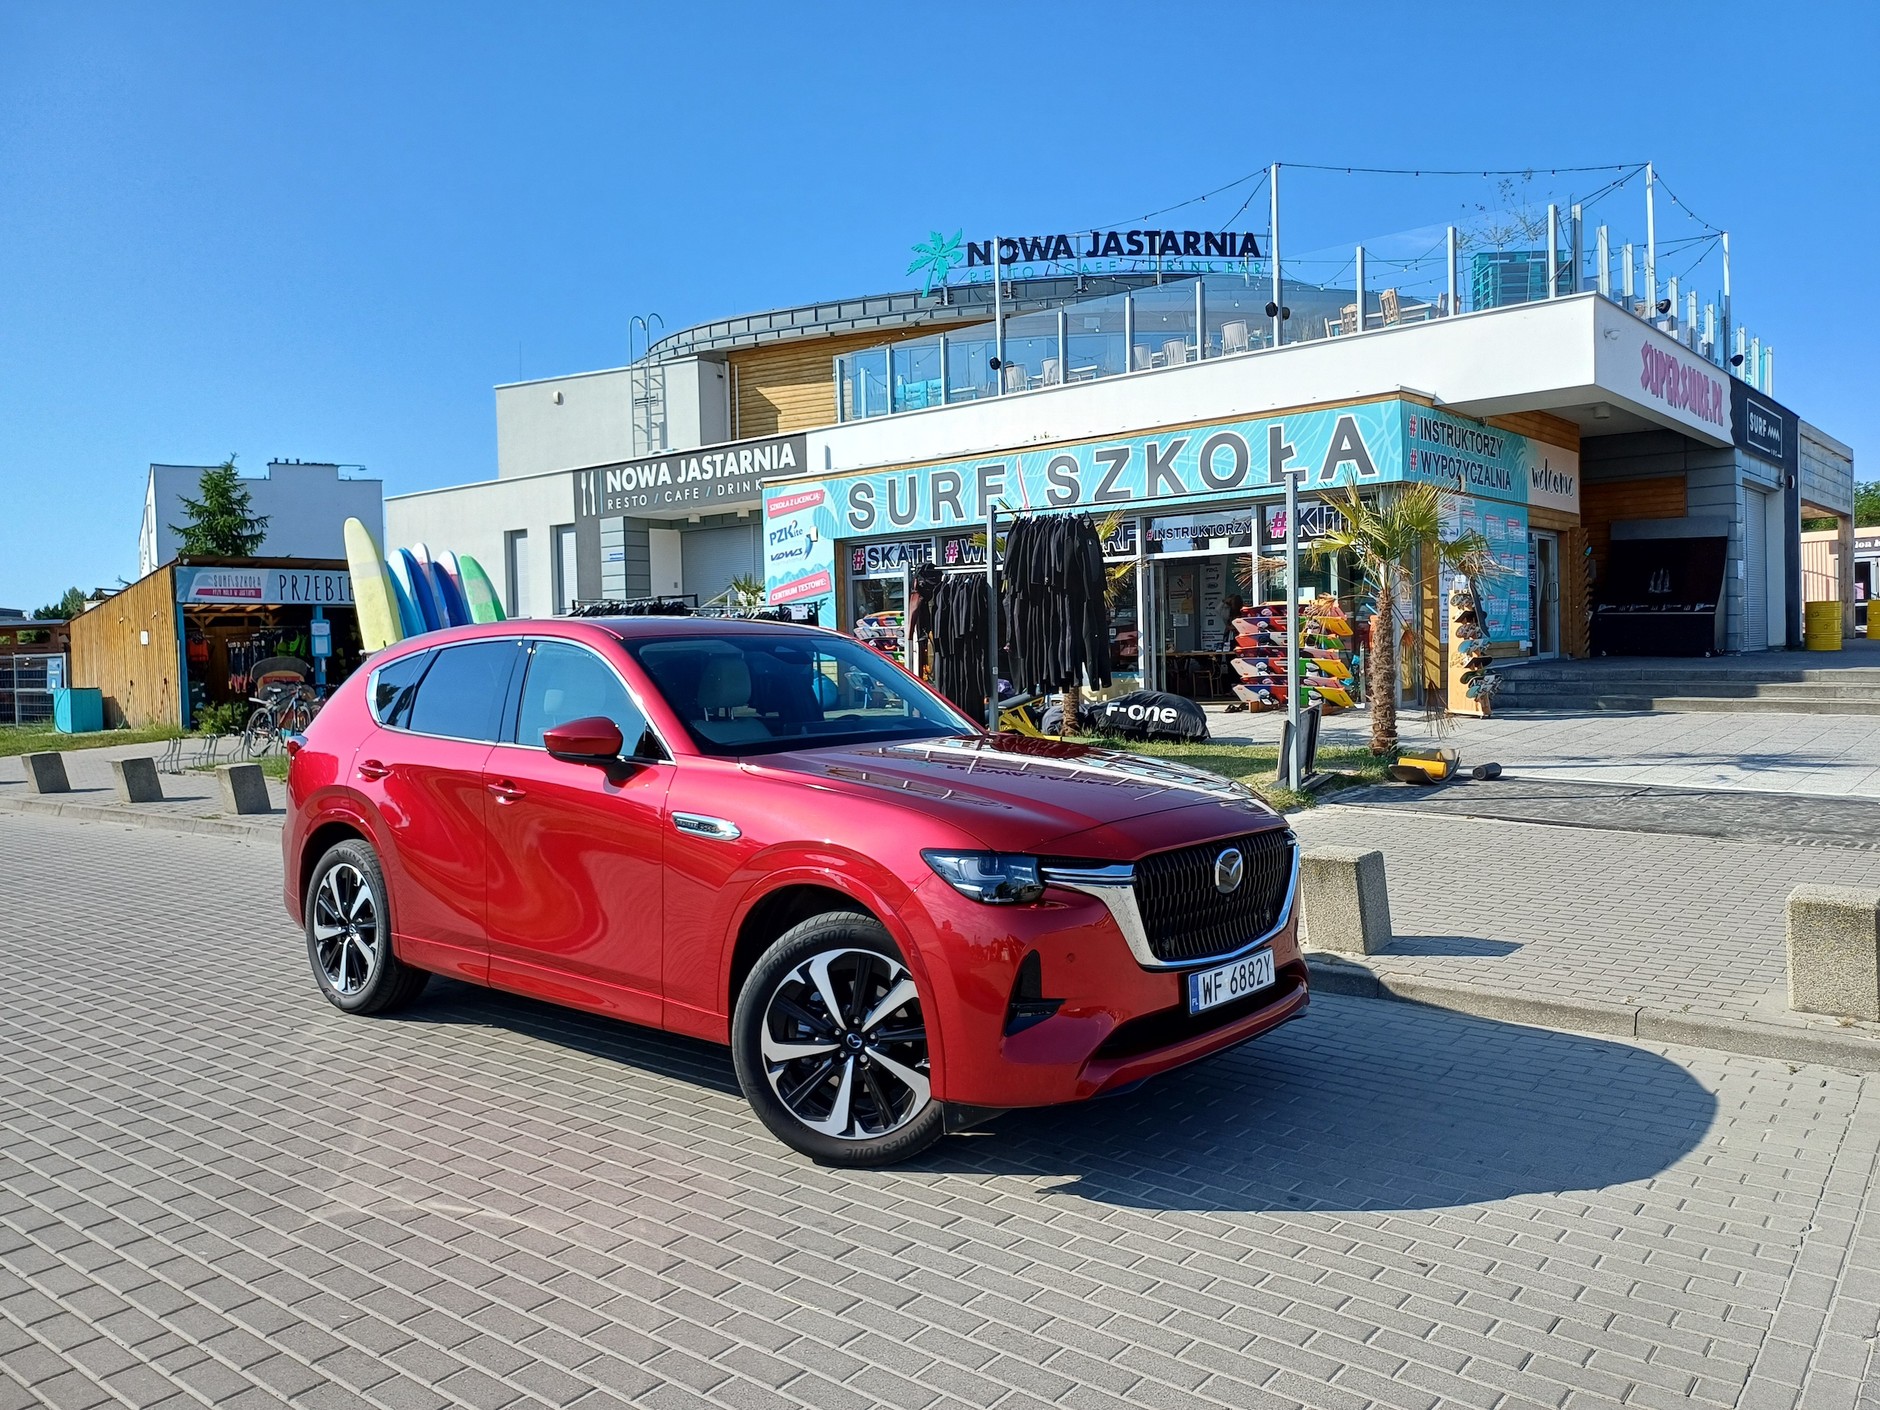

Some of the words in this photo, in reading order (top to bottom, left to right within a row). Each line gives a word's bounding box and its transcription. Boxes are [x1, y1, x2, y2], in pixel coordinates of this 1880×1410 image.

[967, 234, 1075, 267] NOWA
[1085, 230, 1261, 258] JASTARNIA
[970, 266, 1034, 283] RETO
[1063, 259, 1117, 275] CAFE
[1149, 259, 1213, 273] DRINK
[1225, 260, 1261, 274] BAR
[1750, 412, 1766, 437] SURF
[606, 462, 673, 494] NOWA
[676, 442, 796, 484] JASTARNIA
[848, 463, 1006, 531] SURF
[1045, 413, 1380, 506] SZKOŁA
[1531, 457, 1575, 497] welcome
[607, 494, 648, 510] RESTO
[664, 487, 700, 503] CAFE
[1146, 521, 1252, 541] #INSTRUKTORZY
[772, 586, 798, 601] CENTRUM
[1202, 971, 1224, 1006] WF
[1230, 953, 1271, 995] 6882Y
